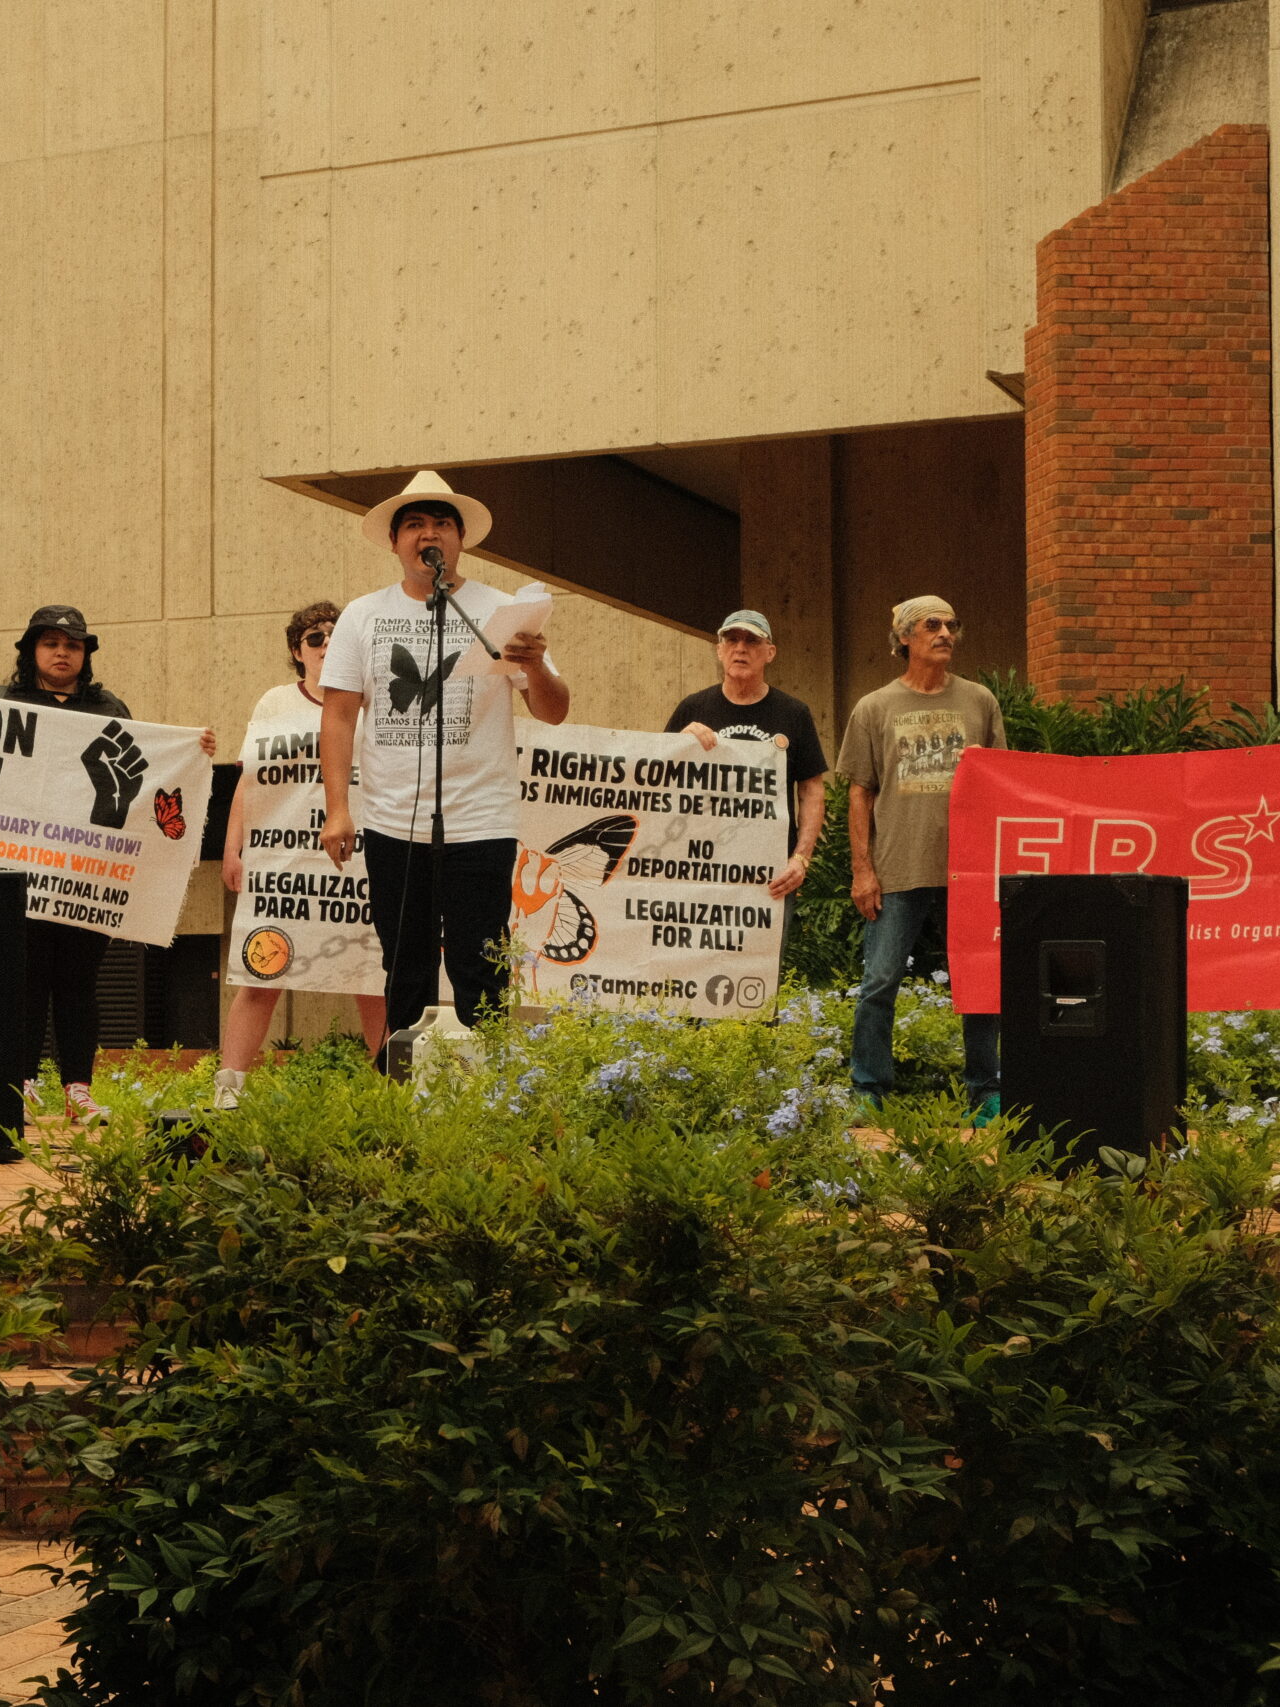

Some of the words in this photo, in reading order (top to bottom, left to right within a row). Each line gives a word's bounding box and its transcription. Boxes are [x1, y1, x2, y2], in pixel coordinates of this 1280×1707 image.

[372, 636, 414, 645] ESTAMOS
[417, 637, 430, 645] EN
[374, 625, 412, 633] RIGHTS
[375, 718, 410, 727] ESTAMOS
[396, 732, 405, 740] DE
[448, 731, 457, 739] DE
[530, 748, 627, 784] RIGHTS
[634, 757, 778, 797] COMMITTEE
[544, 783, 673, 813] INMIGRANTES
[679, 793, 704, 816] DE
[709, 796, 778, 820] TAMPA
[43, 823, 103, 849] CAMPUS
[105, 835, 142, 857] NOW!
[687, 839, 714, 860] NO
[70, 853, 106, 878] WITH
[109, 861, 135, 882] ICE!
[627, 857, 774, 885] DEPORTATIONS!
[103, 890, 130, 907] AND
[254, 895, 310, 920] PARA
[53, 900, 124, 928] STUDENTS!
[625, 898, 772, 929] LEGALIZATION
[651, 925, 692, 949] FOR
[699, 928, 744, 952] ALL!
[570, 973, 698, 999] @TampaIRC
